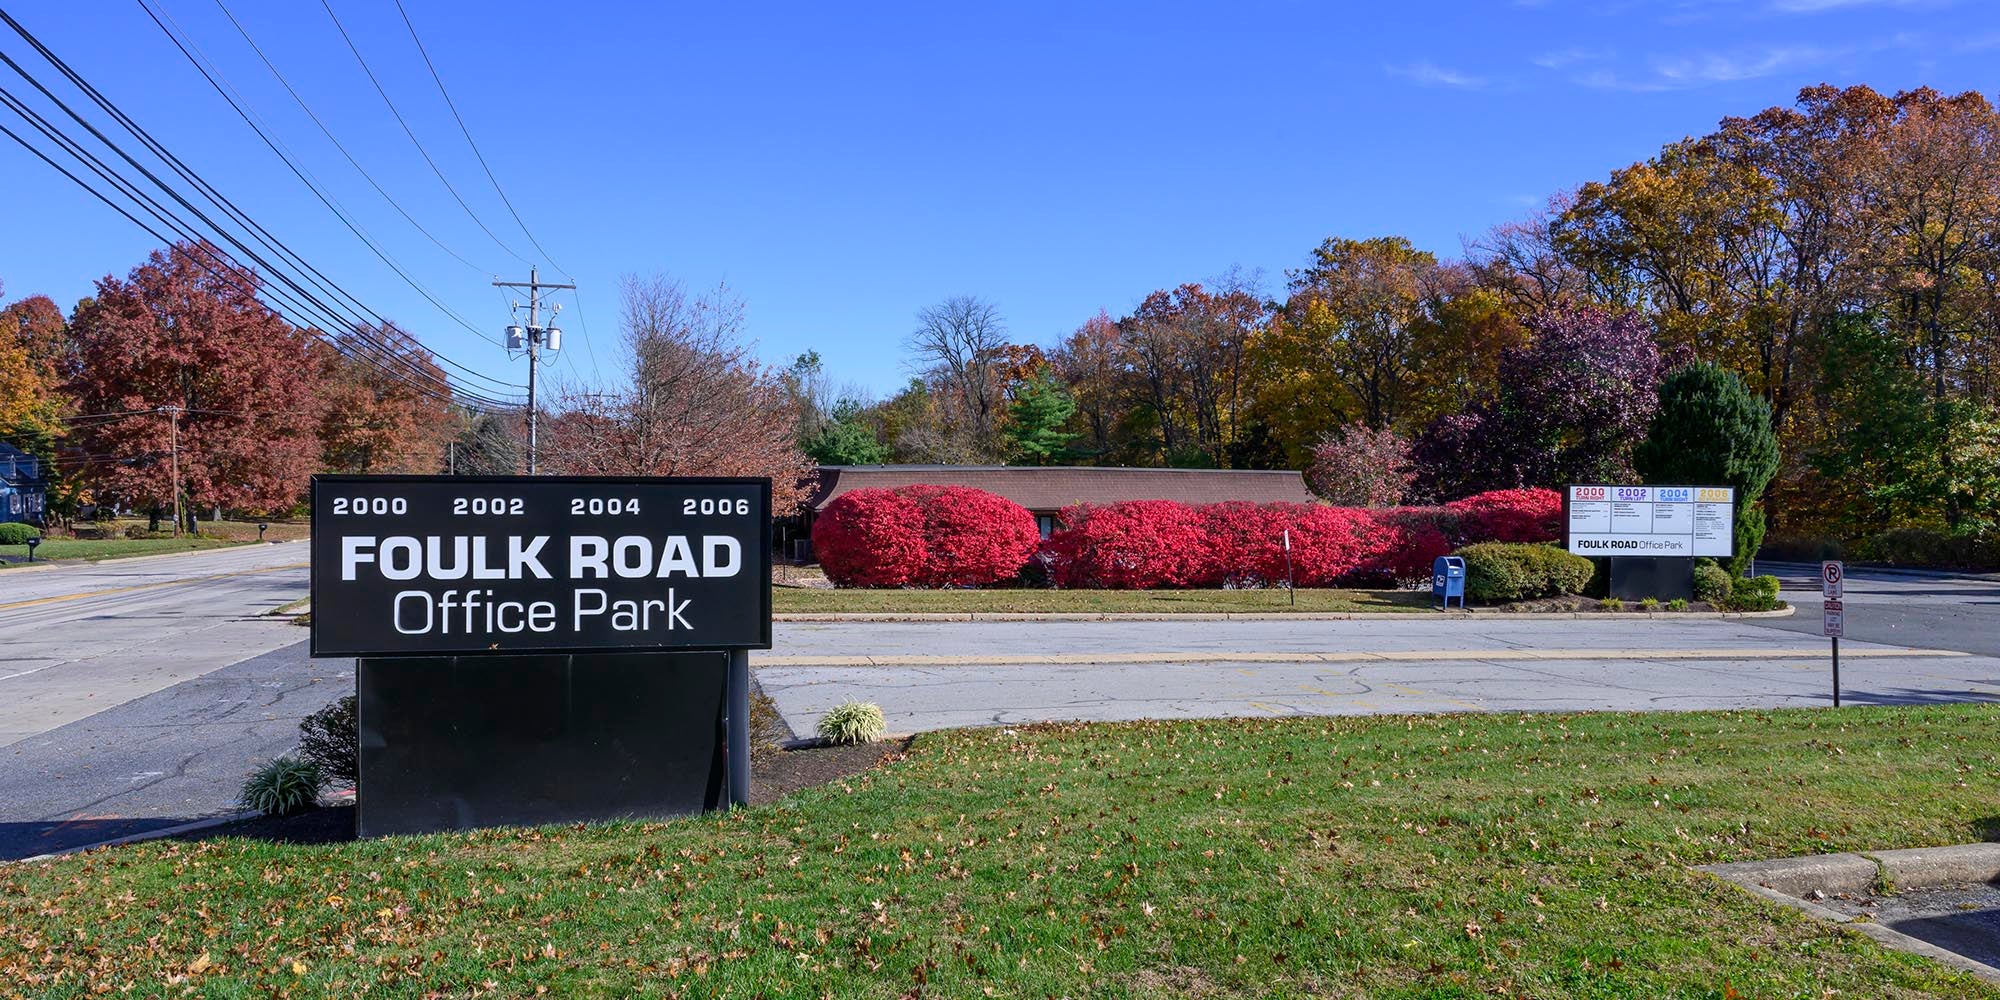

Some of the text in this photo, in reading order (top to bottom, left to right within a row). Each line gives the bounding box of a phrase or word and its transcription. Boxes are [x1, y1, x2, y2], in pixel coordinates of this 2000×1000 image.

[1576, 488, 1604, 496] 2000
[1618, 488, 1646, 496] 2002
[1660, 489, 1688, 497] 2004
[334, 498, 750, 515] 2000 2002 2004 2006
[1578, 540, 1683, 550] FOULK ROAD Office Park
[342, 536, 742, 580] FOULK ROAD
[394, 588, 694, 635] Office Park
